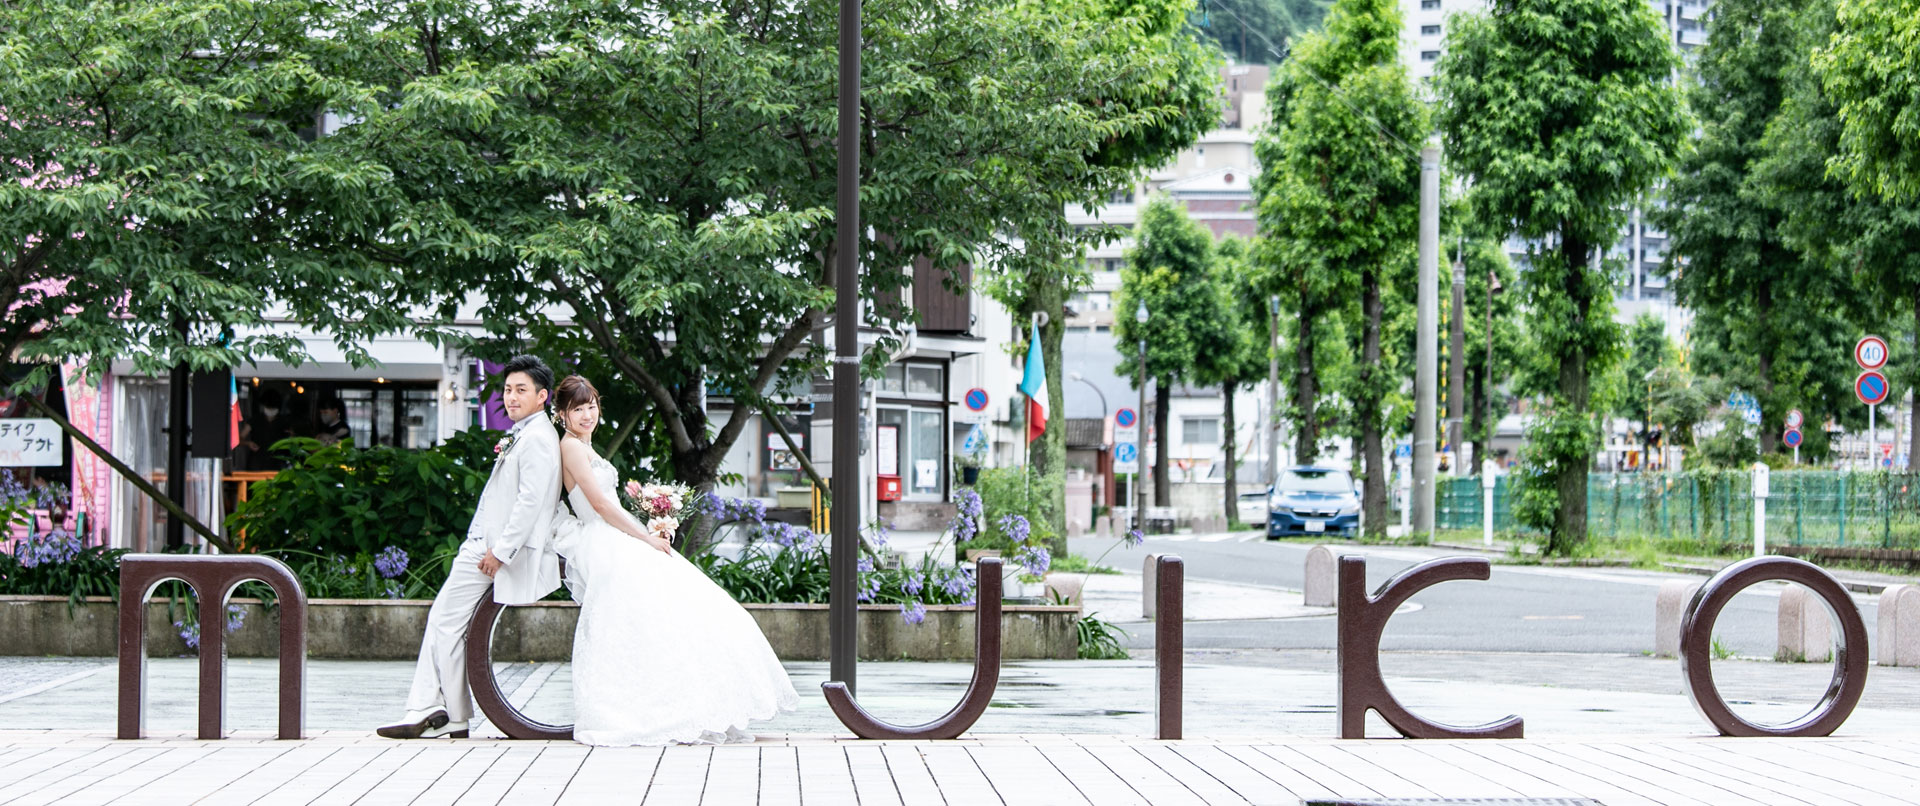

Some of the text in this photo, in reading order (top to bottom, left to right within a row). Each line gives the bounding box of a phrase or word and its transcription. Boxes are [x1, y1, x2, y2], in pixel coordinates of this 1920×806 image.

[1864, 346, 1881, 361] 40
[1, 423, 36, 438] テイク
[23, 438, 54, 452] アウト
